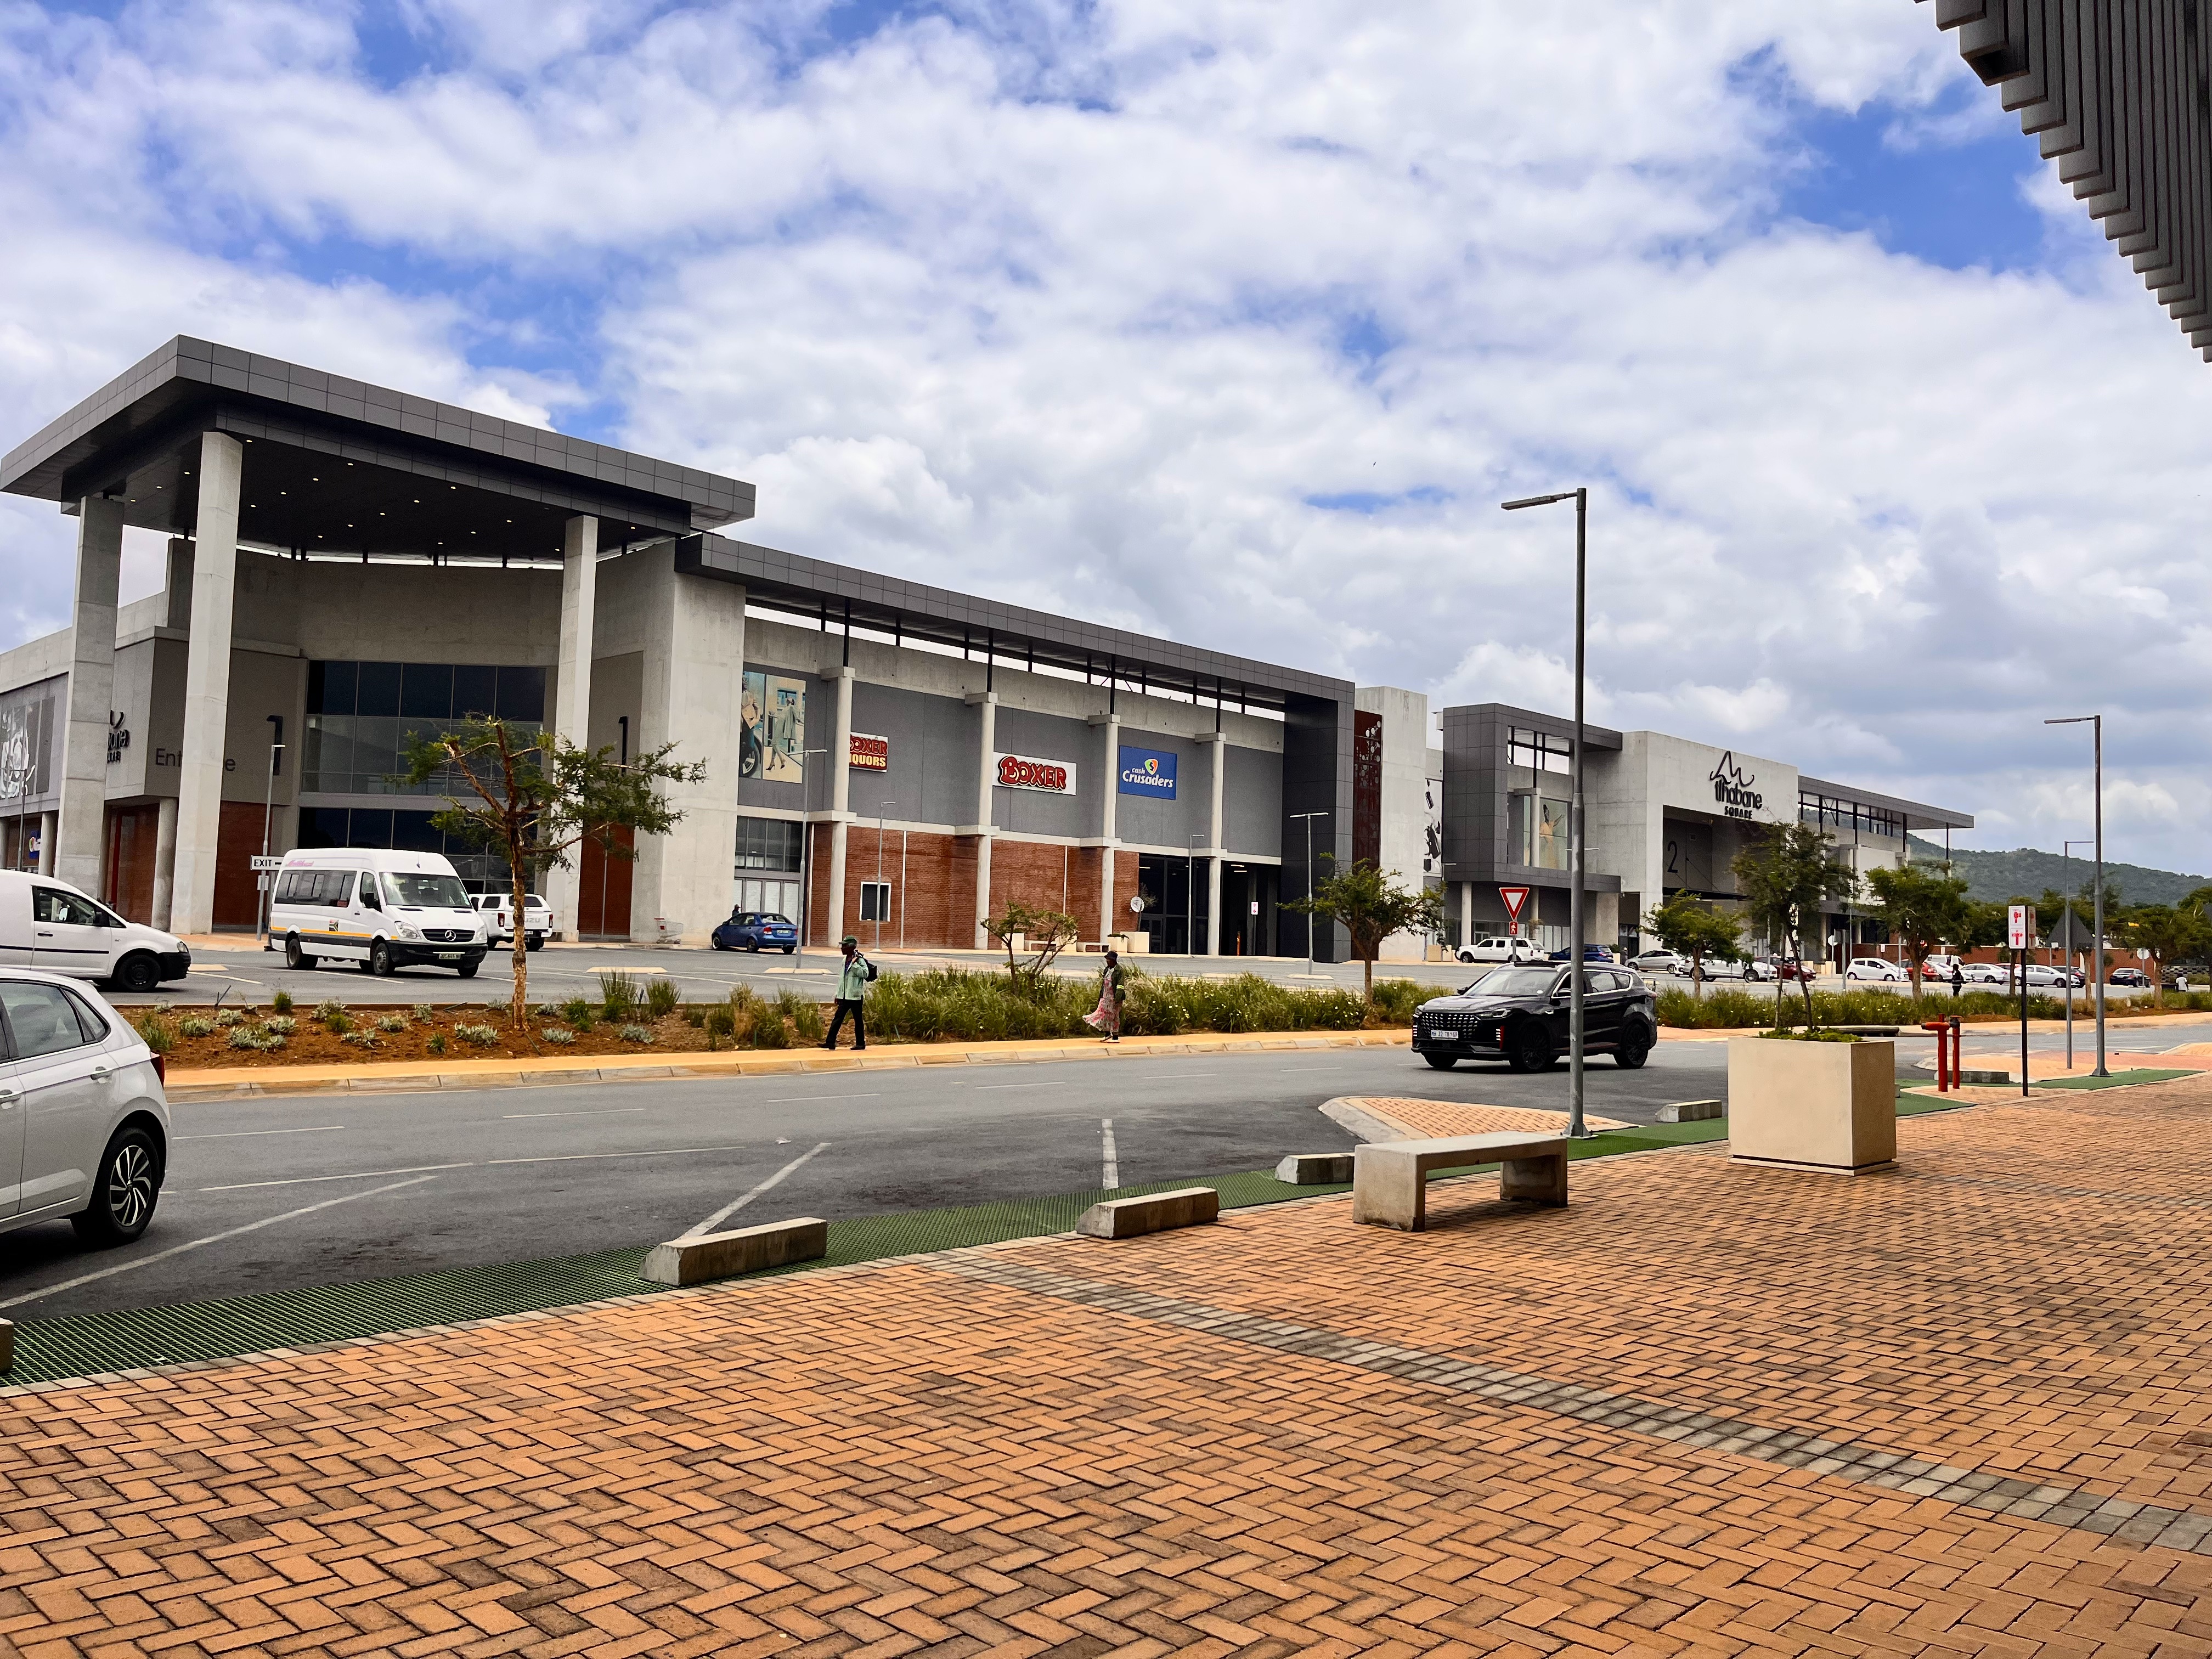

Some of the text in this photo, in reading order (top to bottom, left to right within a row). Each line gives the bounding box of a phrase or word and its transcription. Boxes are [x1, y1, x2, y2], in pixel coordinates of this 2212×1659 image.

[266, 715, 284, 776] 1
[155, 748, 236, 771] Ente
[849, 753, 886, 767] IQUORS
[998, 756, 1066, 791] BOXER
[1122, 770, 1173, 788] Crusaders
[1715, 779, 1762, 809] tlhabane
[1724, 805, 1752, 819] SQUARE
[1667, 840, 1678, 873] 2
